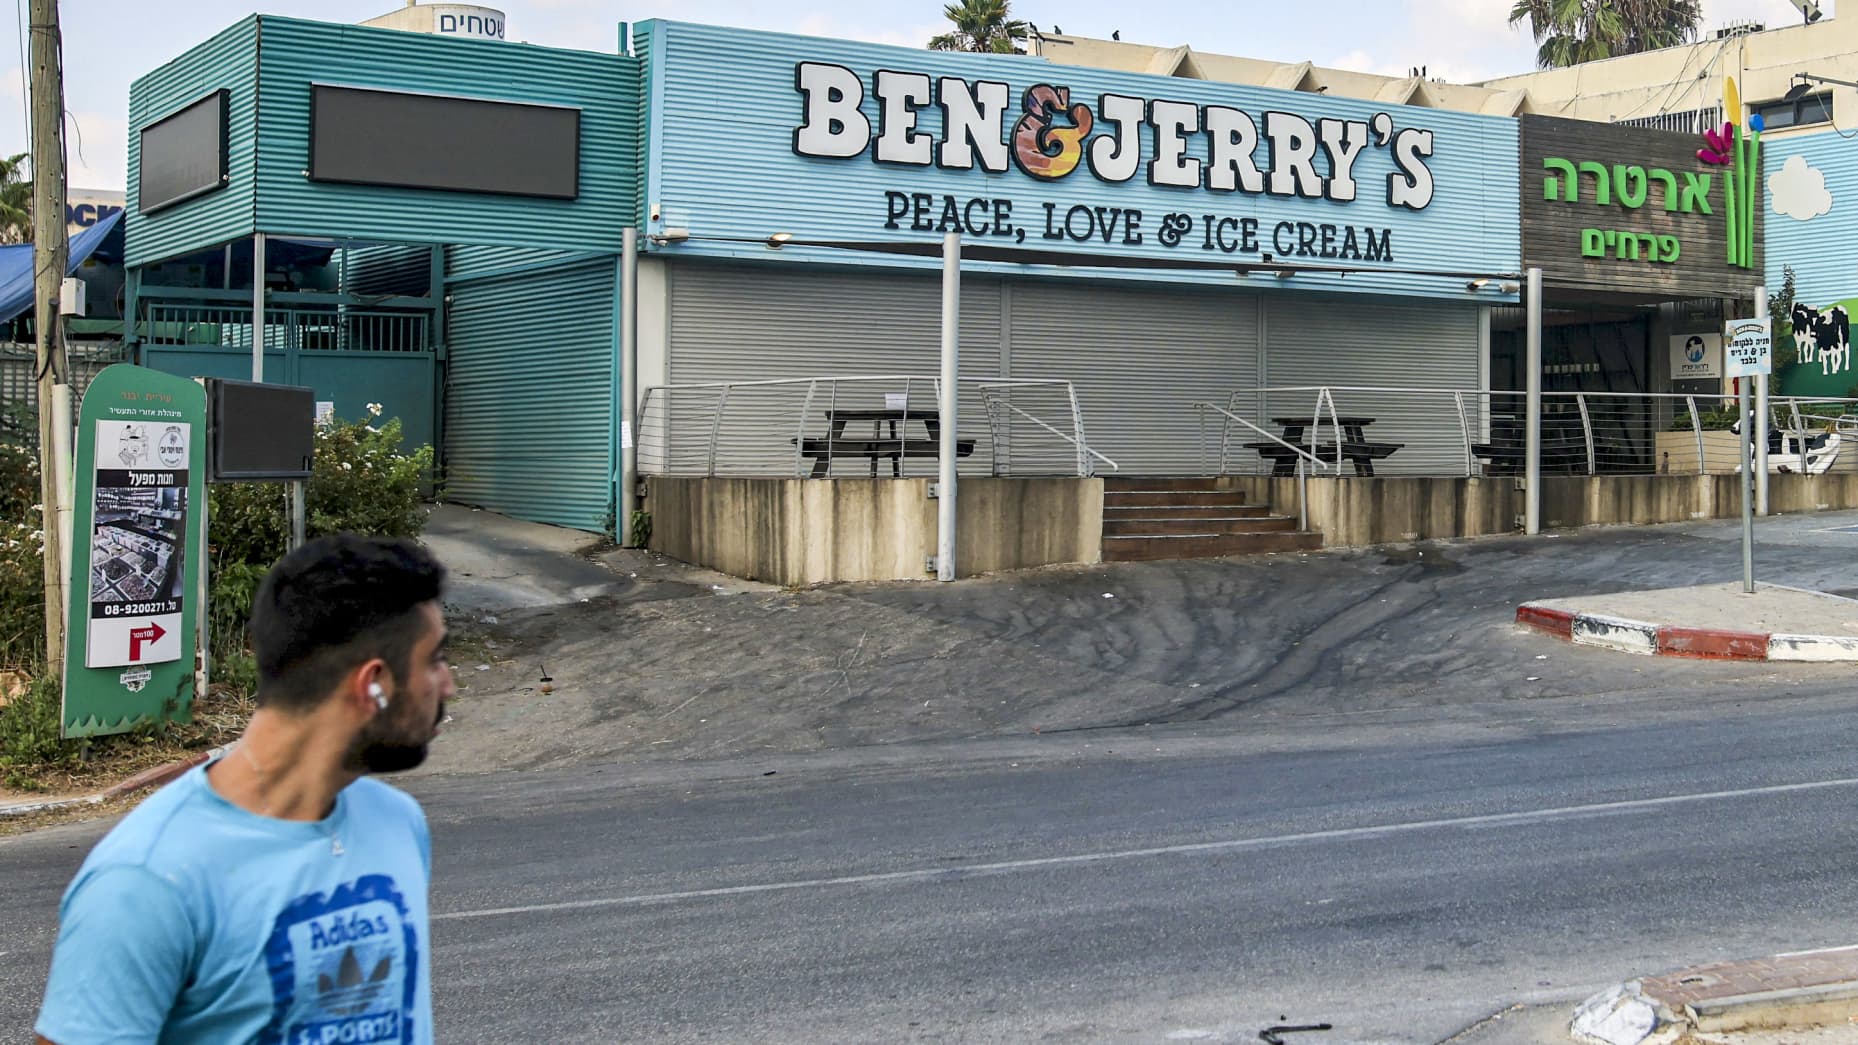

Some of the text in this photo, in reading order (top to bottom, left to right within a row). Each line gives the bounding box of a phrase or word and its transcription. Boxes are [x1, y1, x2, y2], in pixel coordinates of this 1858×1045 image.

[440, 14, 505, 39] שטחים
[1543, 157, 1713, 215] ארטרה
[884, 190, 1394, 262] PEACE, LOVE & ICE CREAM
[1581, 228, 1681, 263] פרחים
[128, 470, 174, 487] חנות מפעל
[104, 601, 165, 616] 08-9200271
[310, 911, 389, 950] Adidas
